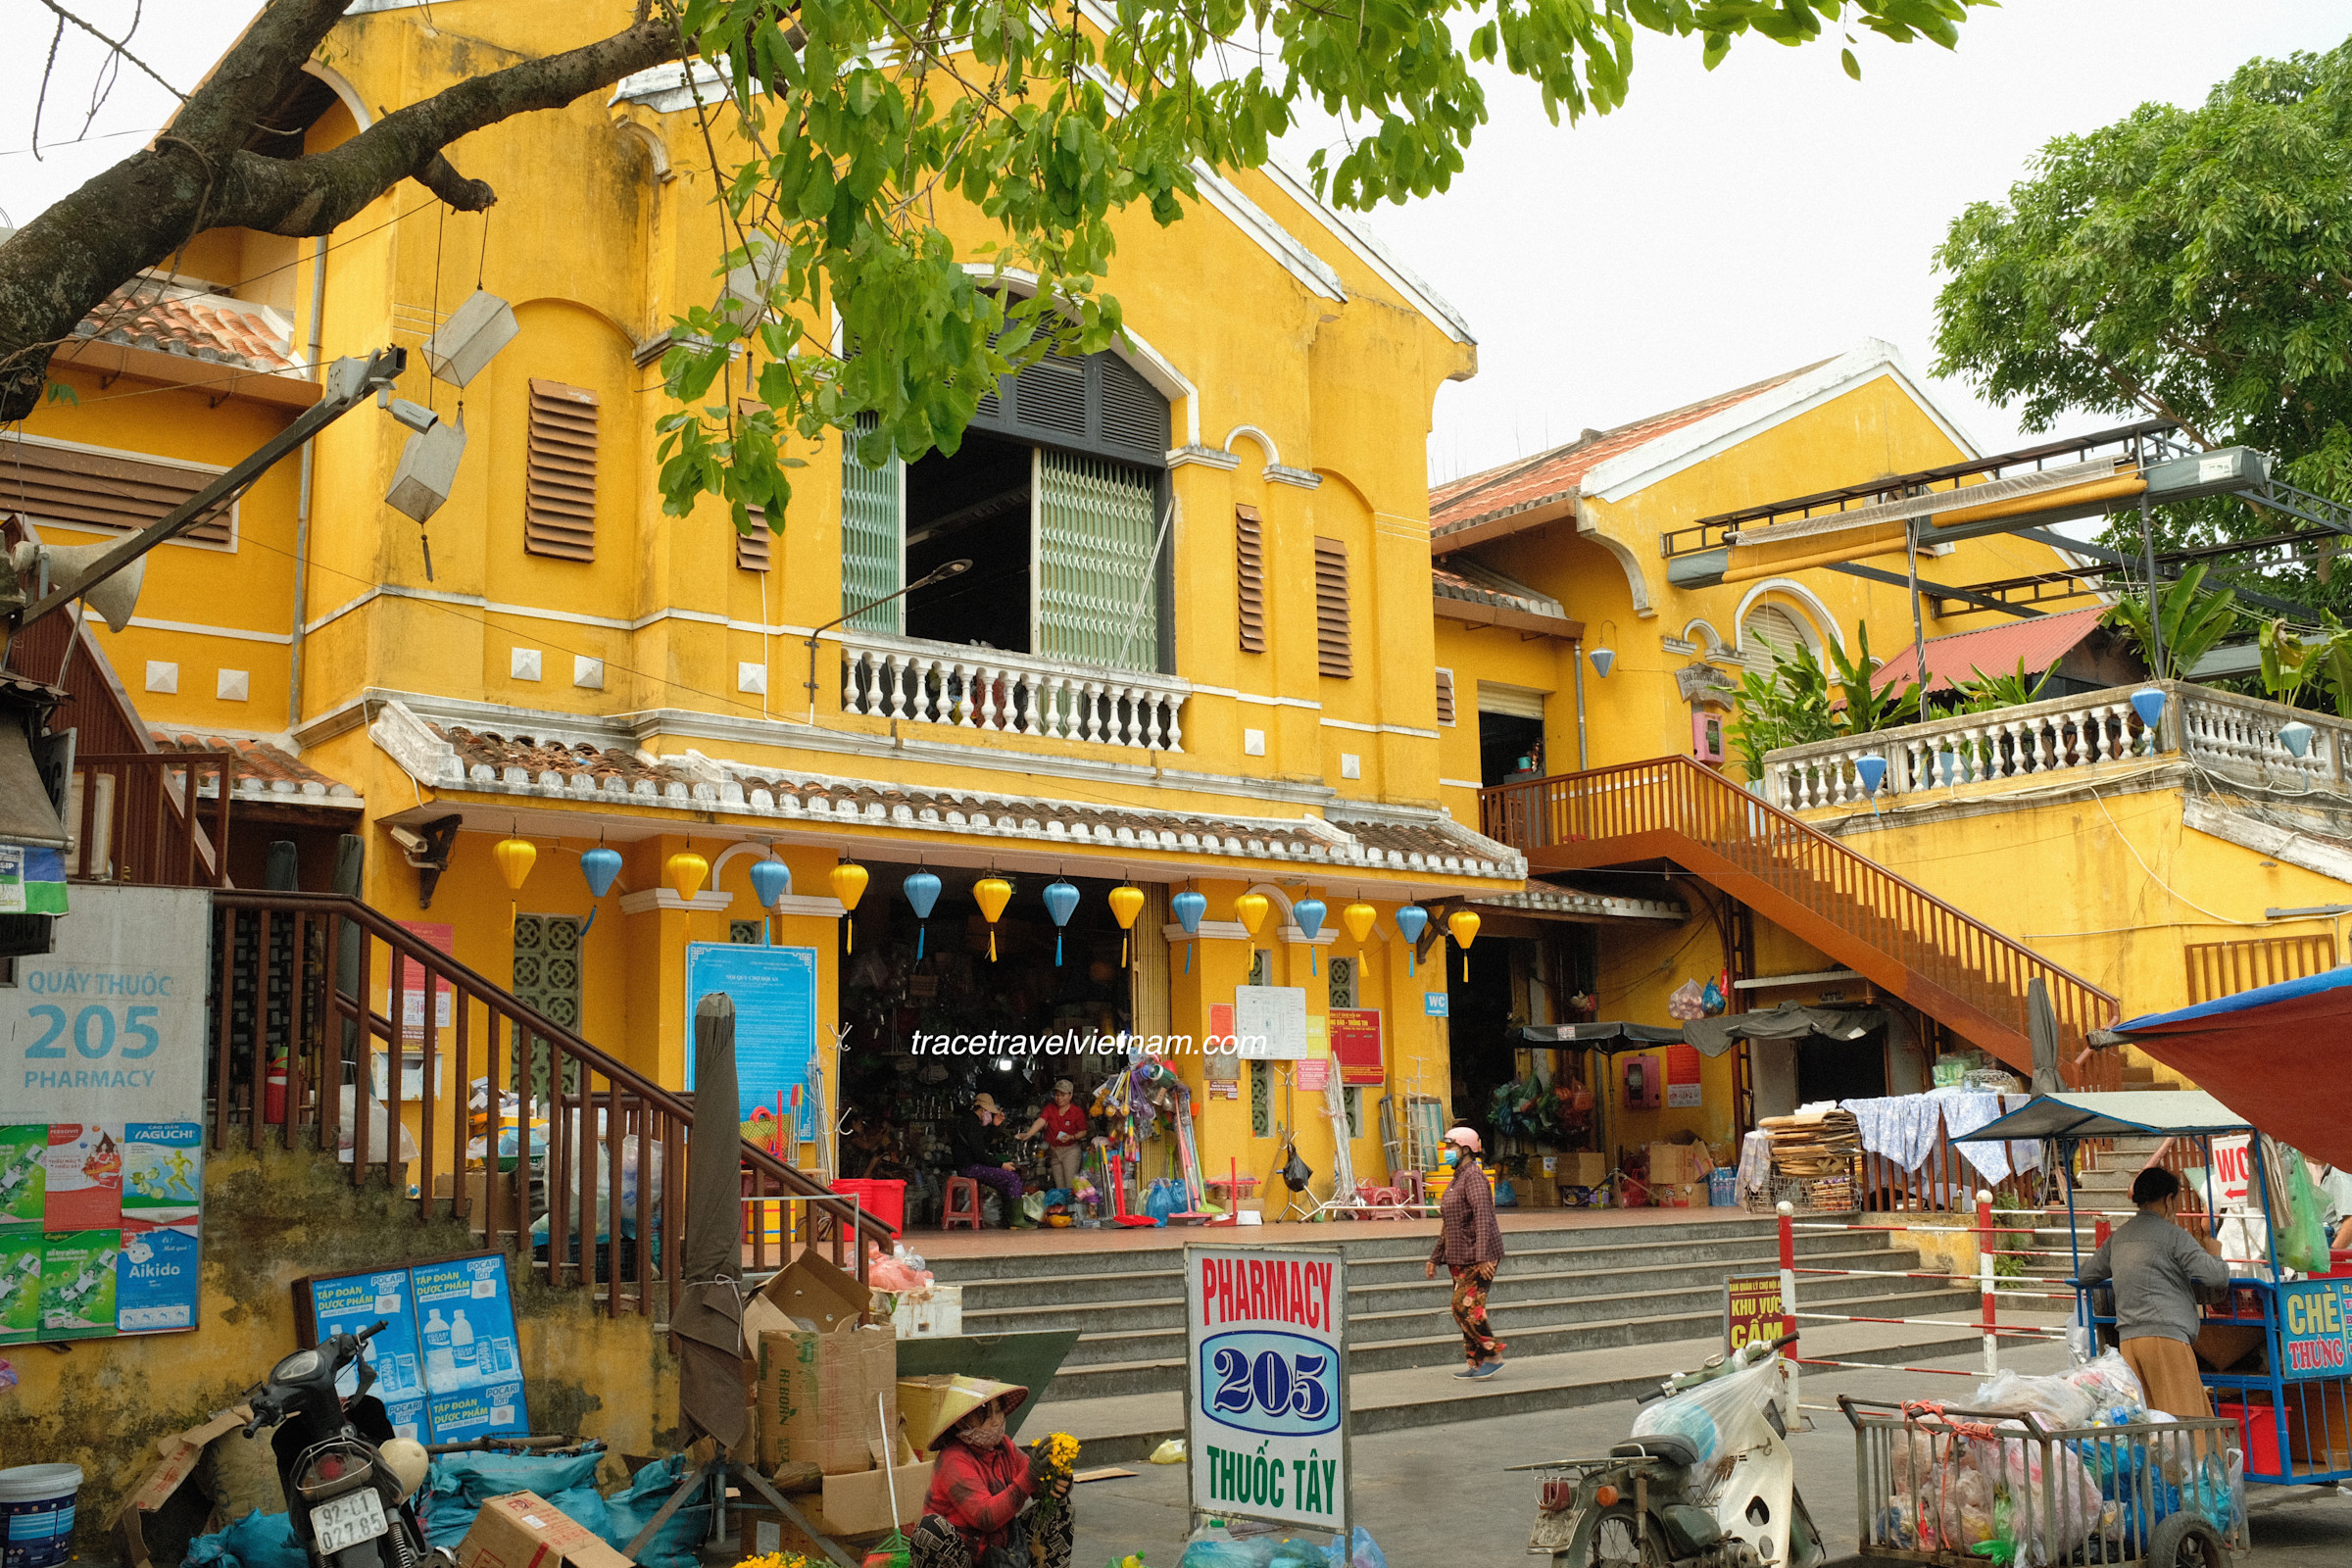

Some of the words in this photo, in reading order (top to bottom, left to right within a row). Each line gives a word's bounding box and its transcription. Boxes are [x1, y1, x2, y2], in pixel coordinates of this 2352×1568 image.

[27, 965, 90, 996] QUẦY
[95, 967, 172, 997] THUỐC
[1428, 995, 1446, 1008] WC
[24, 1004, 160, 1059] 205
[24, 1069, 155, 1089] PHARMACY
[134, 1130, 194, 1140] YAGUCHI
[2215, 1146, 2249, 1184] WC
[128, 1262, 180, 1279] Aikido
[467, 1258, 500, 1271] POCARI
[371, 1272, 406, 1286] POCARI
[416, 1275, 432, 1287] TẬP
[433, 1271, 460, 1283] ĐOÀN
[317, 1289, 334, 1301] TẬP
[336, 1286, 363, 1298] ĐOÀN
[416, 1284, 443, 1297] DƯỢC
[1201, 1257, 1333, 1333] PHARMACY
[318, 1298, 345, 1311] DƯỢC
[1731, 1298, 1756, 1317] KHU
[1759, 1295, 1782, 1318] VỰC
[2286, 1284, 2341, 1336] CHÈ
[1731, 1314, 1784, 1349] CẤM
[2287, 1334, 2344, 1370] THƯNG
[486, 1383, 519, 1398] POCARI
[1212, 1348, 1330, 1421] 205
[433, 1403, 450, 1415] TẬP
[452, 1398, 478, 1410] ĐOÀN
[778, 1368, 791, 1426] REBORN
[389, 1400, 422, 1415] POCARI
[434, 1411, 461, 1424] DƯỢC
[1206, 1440, 1285, 1508] THUỐC
[1293, 1447, 1337, 1515] TÂY
[321, 1494, 369, 1527] 92-C1
[321, 1513, 382, 1550] 027.85
